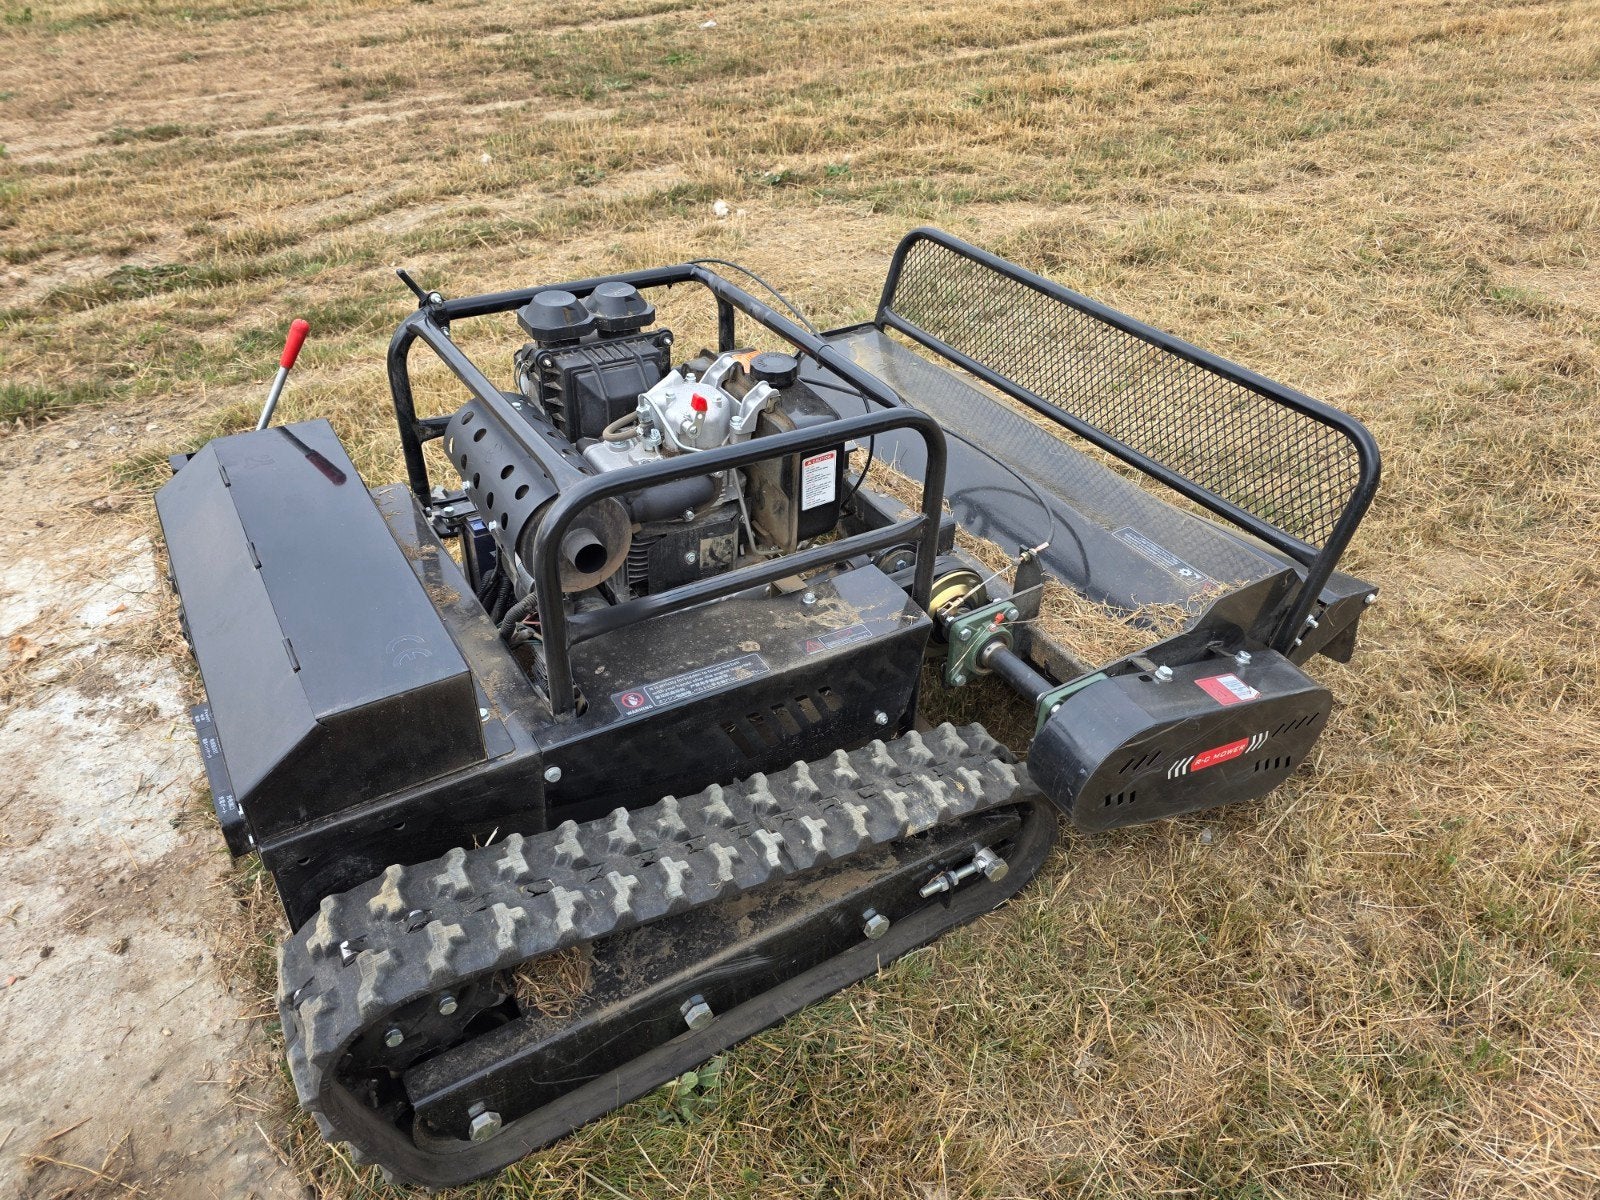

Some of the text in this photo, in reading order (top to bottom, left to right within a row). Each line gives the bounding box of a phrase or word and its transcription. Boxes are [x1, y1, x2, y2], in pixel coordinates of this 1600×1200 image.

[676, 673, 702, 682] forbidden
[626, 704, 654, 716] WARNING
[1194, 744, 1246, 766] R-C MOWER
